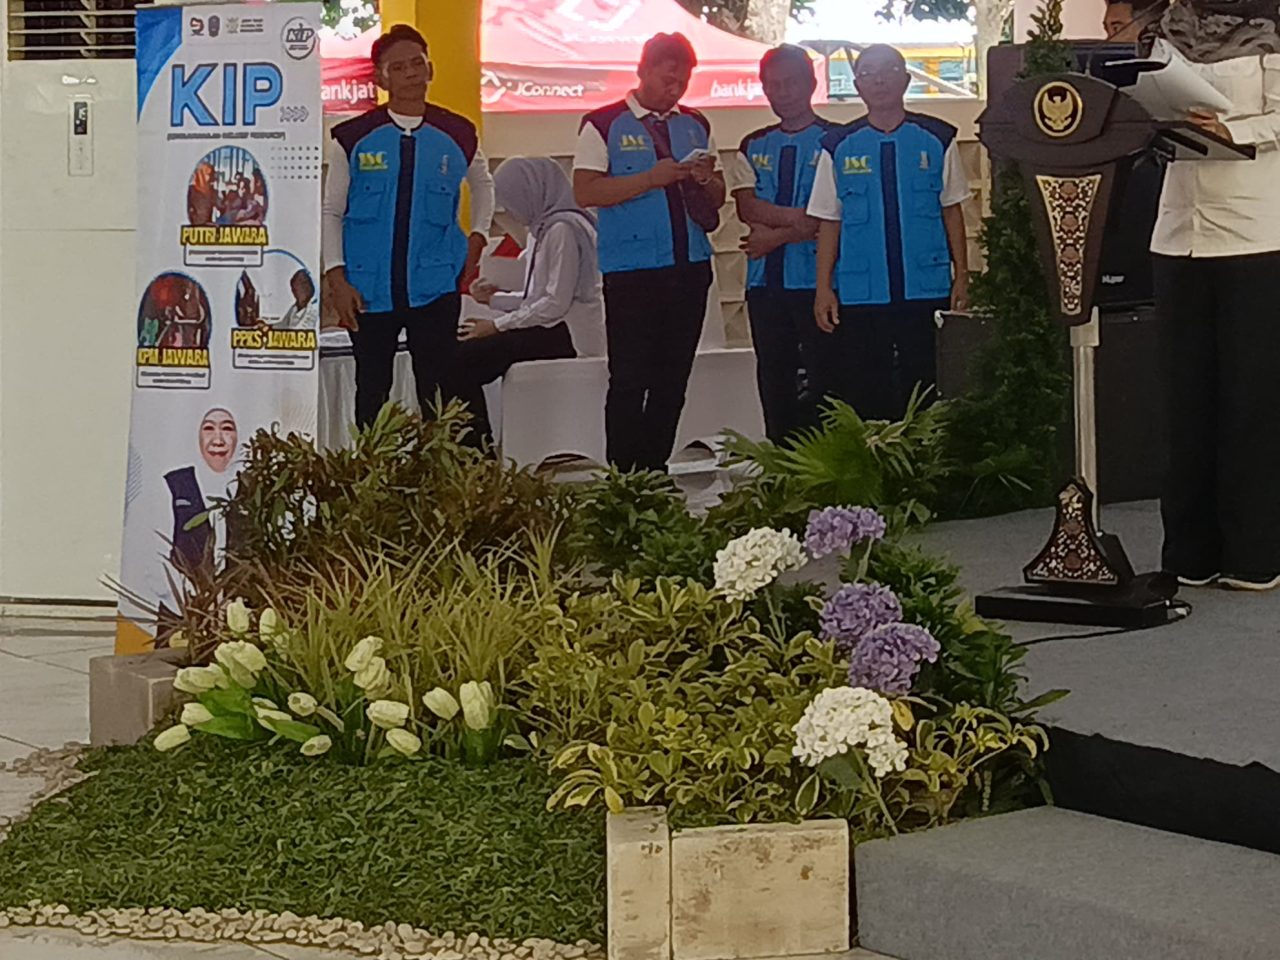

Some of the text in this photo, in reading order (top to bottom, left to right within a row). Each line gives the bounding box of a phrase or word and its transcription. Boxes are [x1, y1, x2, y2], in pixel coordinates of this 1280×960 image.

[170, 61, 283, 127] KIP
[321, 79, 375, 105] ankjat
[513, 81, 585, 98] JConnect
